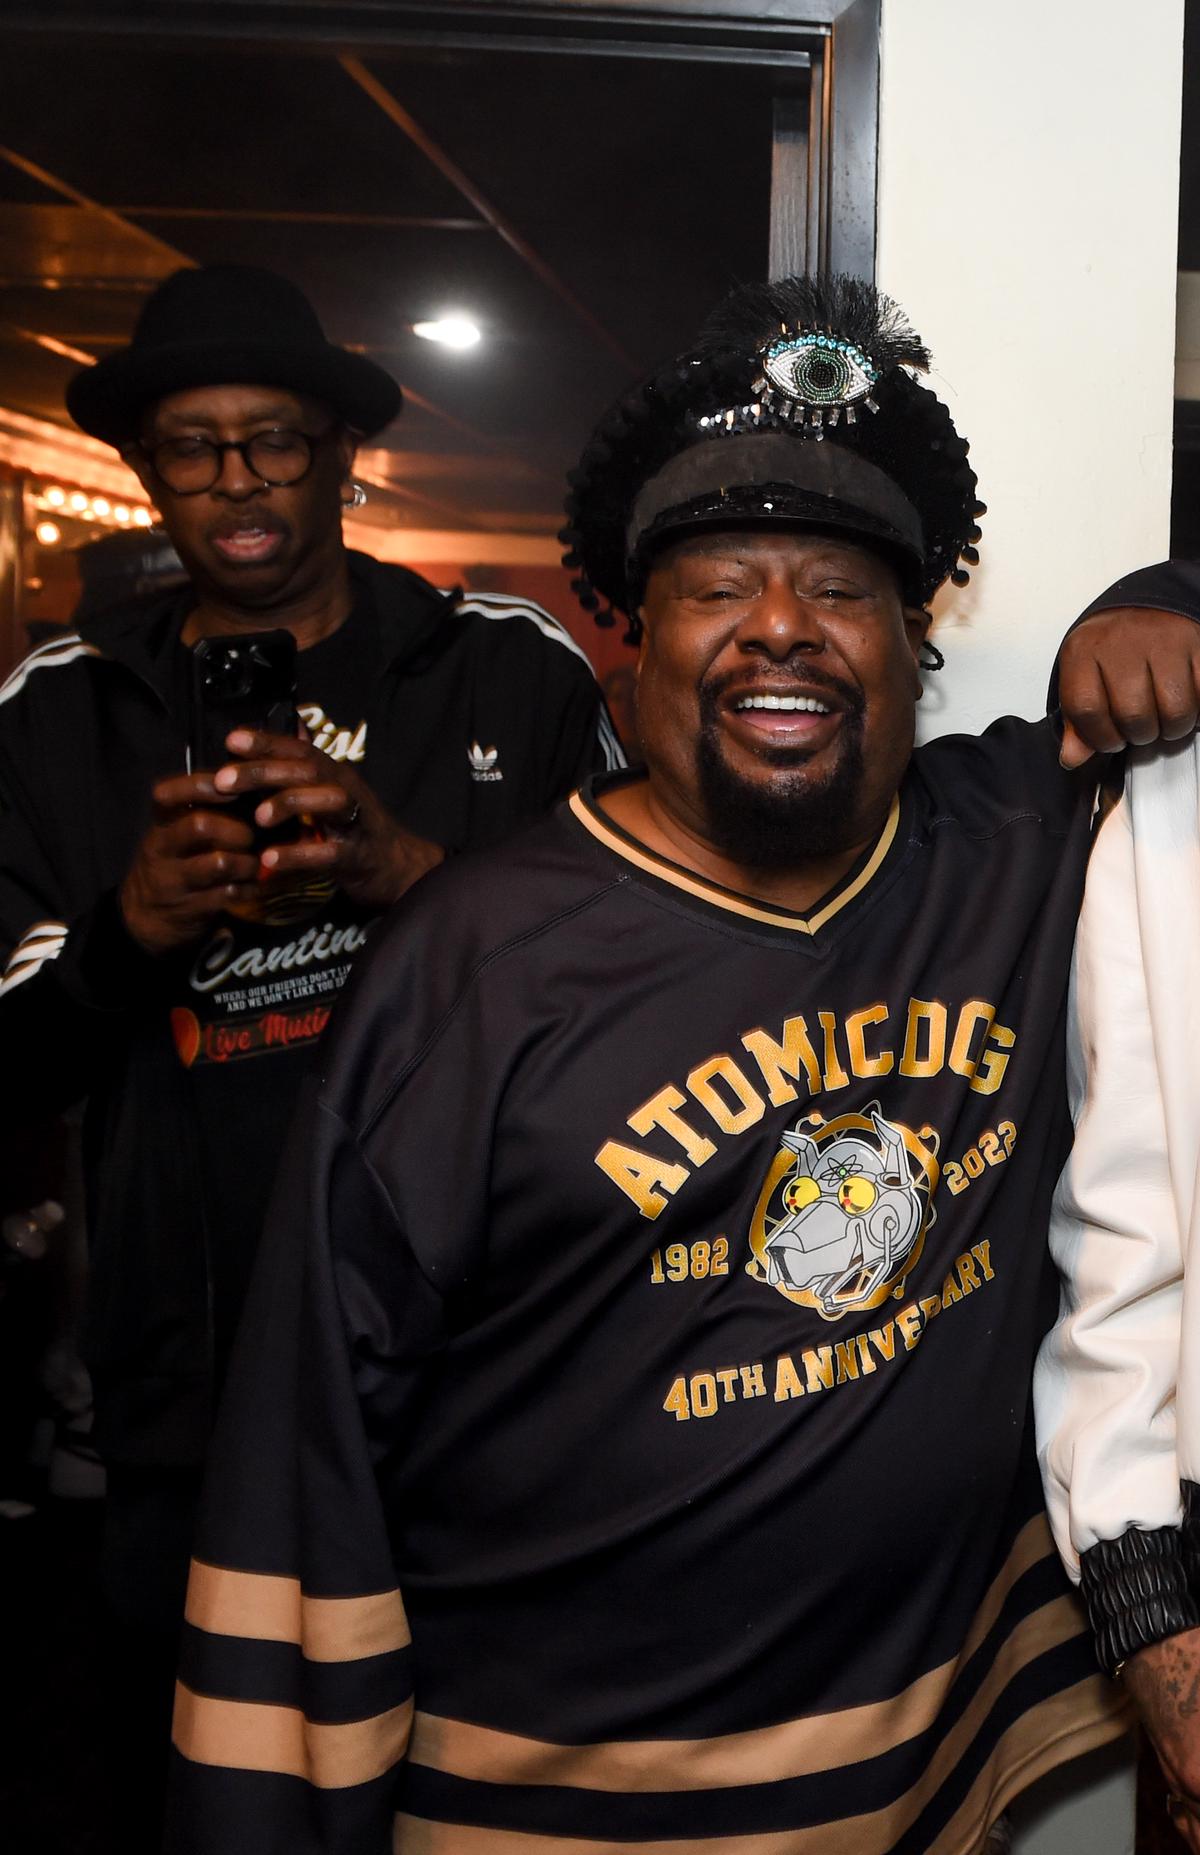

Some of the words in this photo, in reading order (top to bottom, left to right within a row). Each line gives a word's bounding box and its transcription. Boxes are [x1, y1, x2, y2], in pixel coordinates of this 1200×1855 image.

[227, 999, 247, 1013] AND
[248, 995, 263, 1008] WE
[264, 989, 292, 1005] DON'T
[292, 982, 316, 999] LIKE
[316, 978, 334, 993] YOU
[248, 984, 267, 997] OUR
[268, 975, 309, 993] FRIENDS
[309, 967, 336, 984] DON'T
[205, 1024, 252, 1064] Live
[942, 1120, 1017, 1196] 2022
[650, 1237, 729, 1284] 1982
[662, 1364, 768, 1421] 40TH
